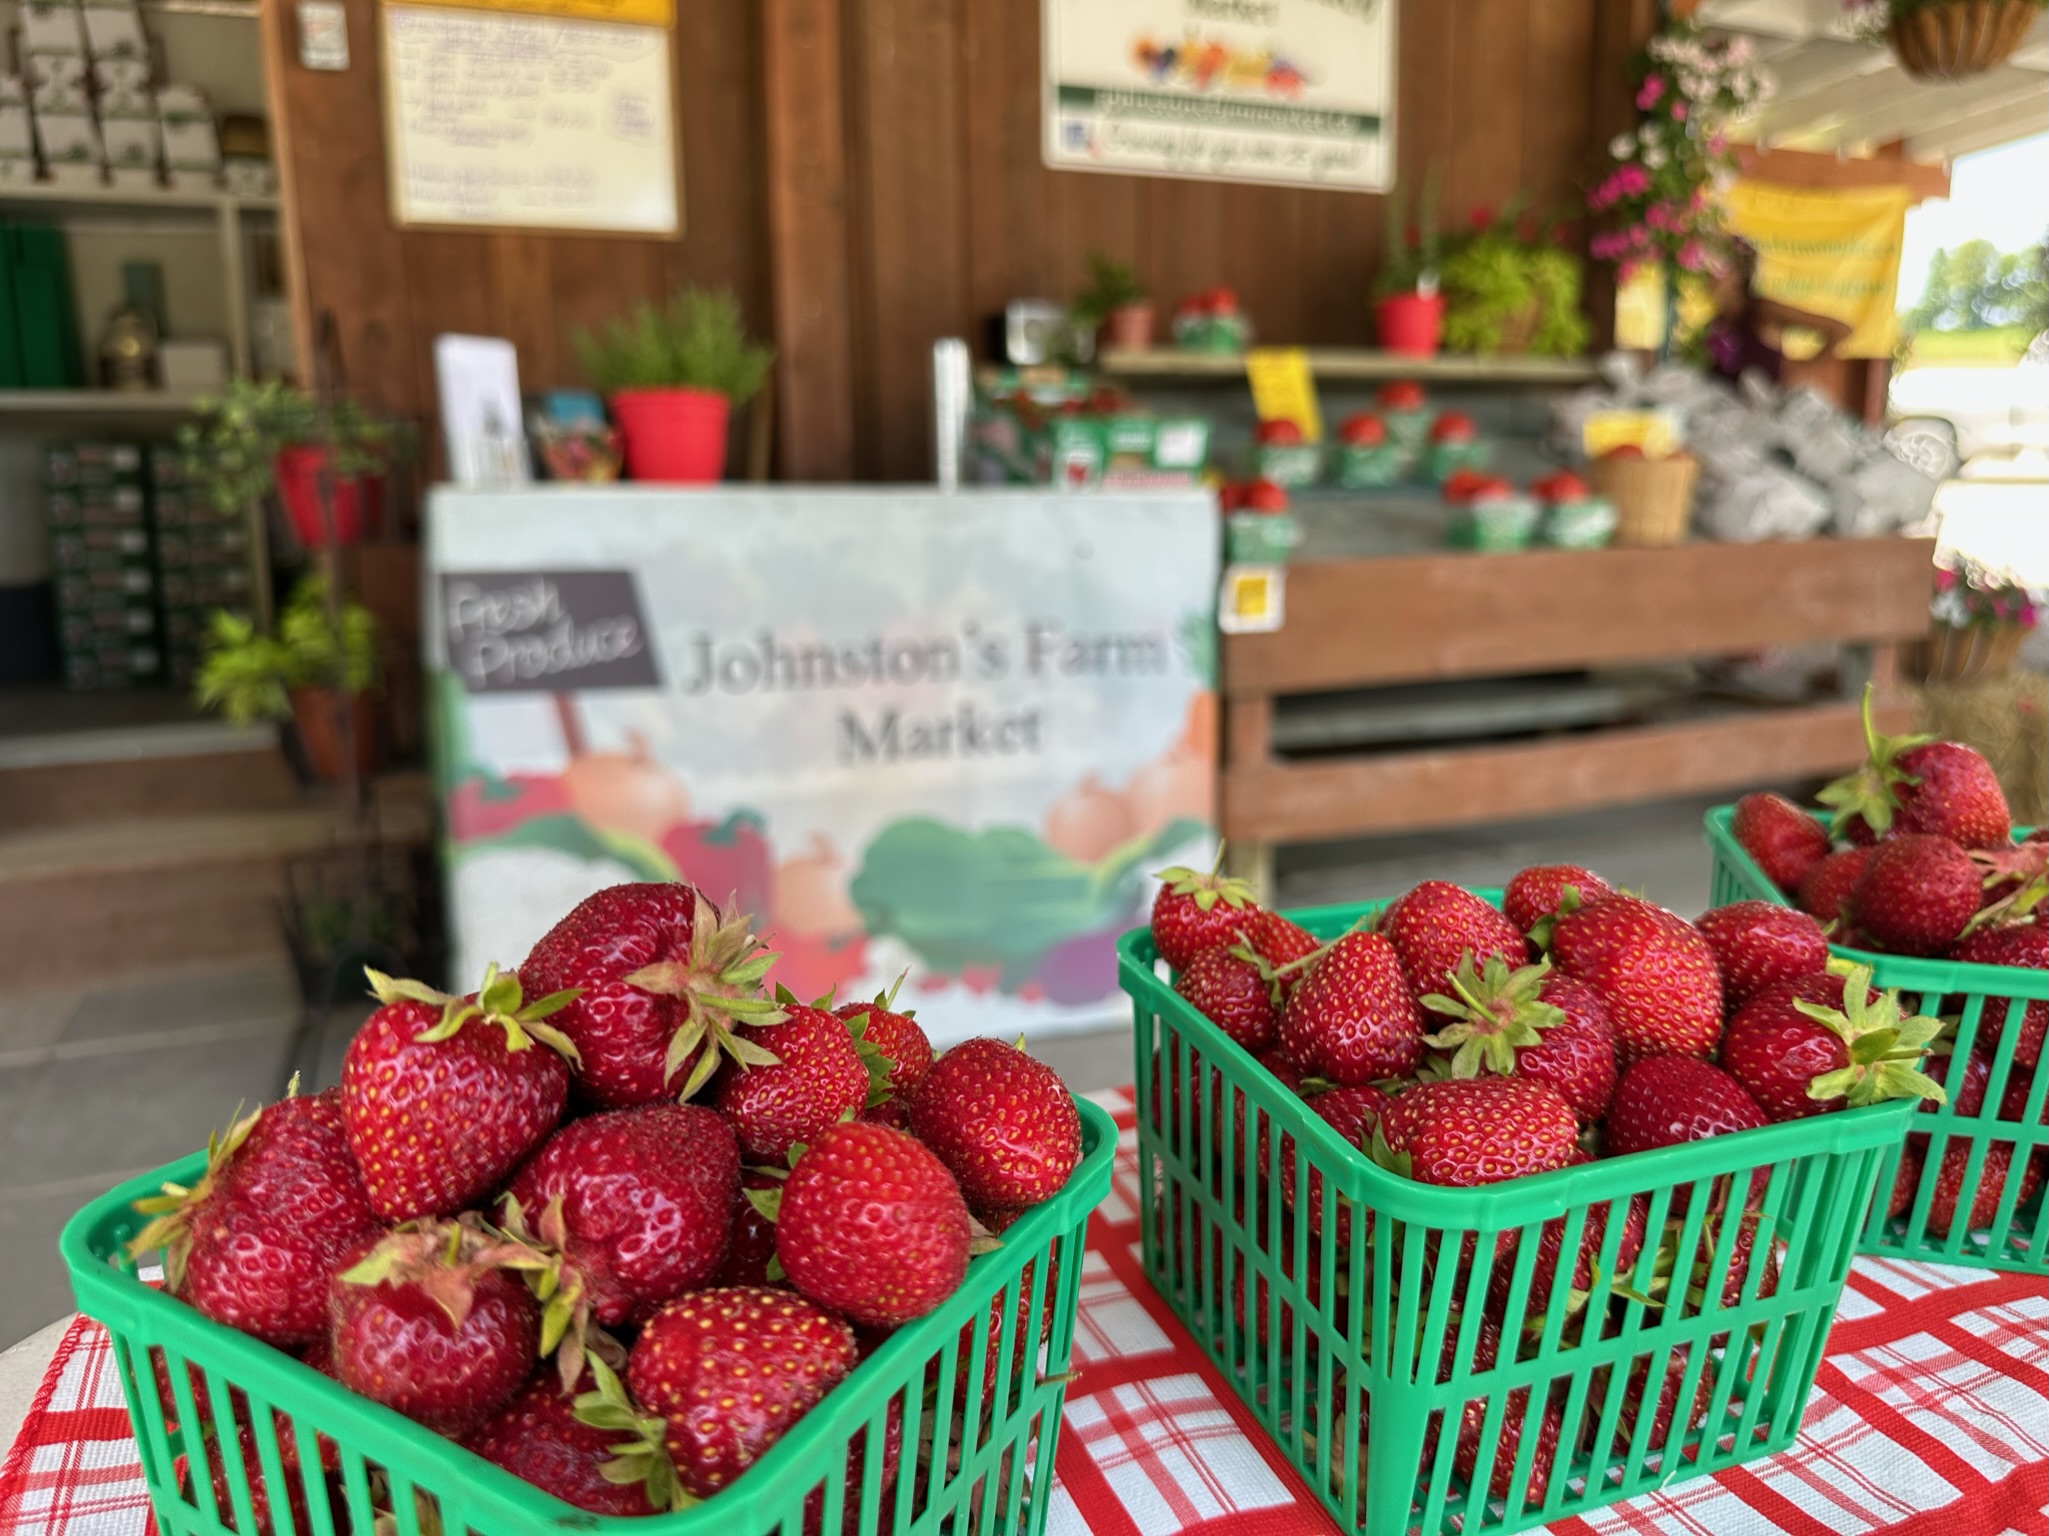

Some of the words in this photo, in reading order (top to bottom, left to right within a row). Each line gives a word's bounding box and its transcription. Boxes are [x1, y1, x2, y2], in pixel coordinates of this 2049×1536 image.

[449, 577, 561, 640] Fresh
[466, 614, 643, 688] Produce
[683, 619, 1008, 694] Johnston's
[1024, 616, 1168, 679] Farm
[838, 699, 1045, 766] Market
